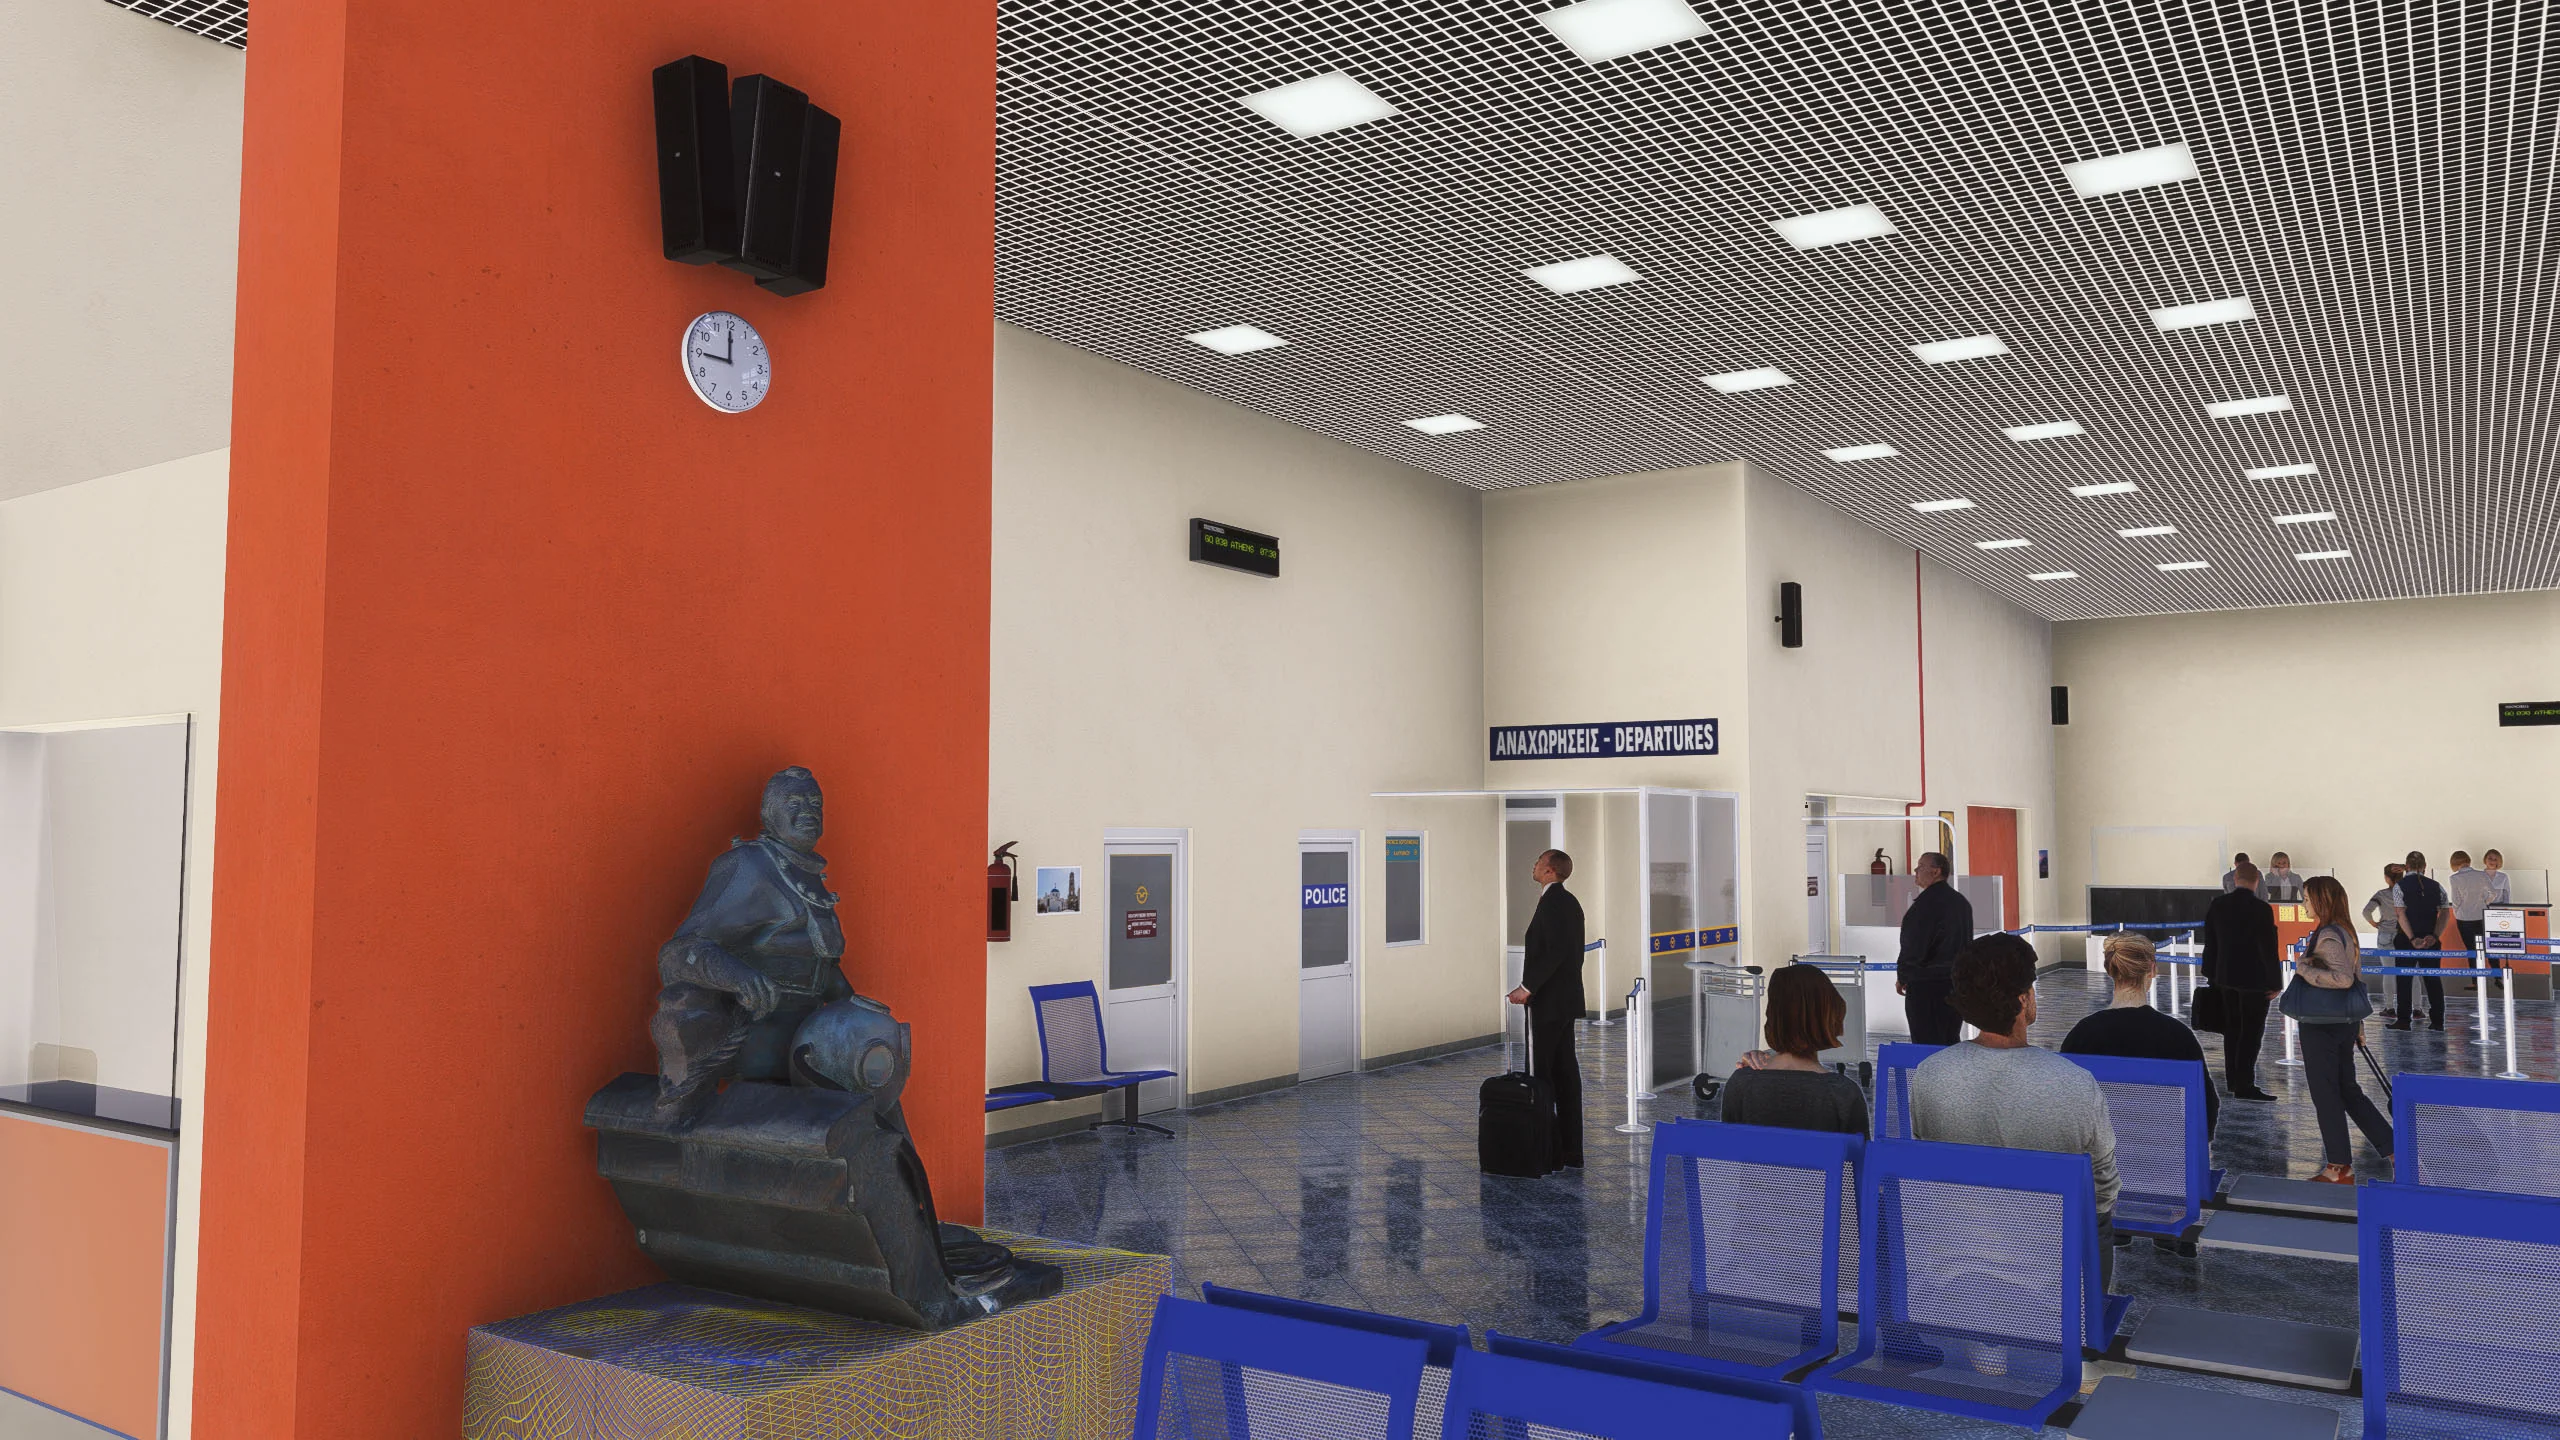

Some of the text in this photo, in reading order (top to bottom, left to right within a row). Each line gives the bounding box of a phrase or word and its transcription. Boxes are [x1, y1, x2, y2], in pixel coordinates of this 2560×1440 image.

[713, 322, 720, 332] 11
[726, 320, 735, 330] 12
[701, 331, 710, 342] 10
[743, 331, 747, 340] 1
[696, 347, 702, 357] 9
[752, 346, 758, 355] 2
[699, 367, 706, 377] 8
[757, 365, 763, 374] 3
[711, 382, 717, 392] 7
[752, 382, 758, 391] 4
[726, 391, 732, 400] 6
[741, 391, 747, 400] 5
[1230, 541, 1254, 554] ATHENS
[1496, 728, 1599, 756] ΑΝΑΧΩΡΗΣΕΙΣ
[1615, 724, 1714, 753] DEPARTURES
[1305, 887, 1346, 905] POLICE
